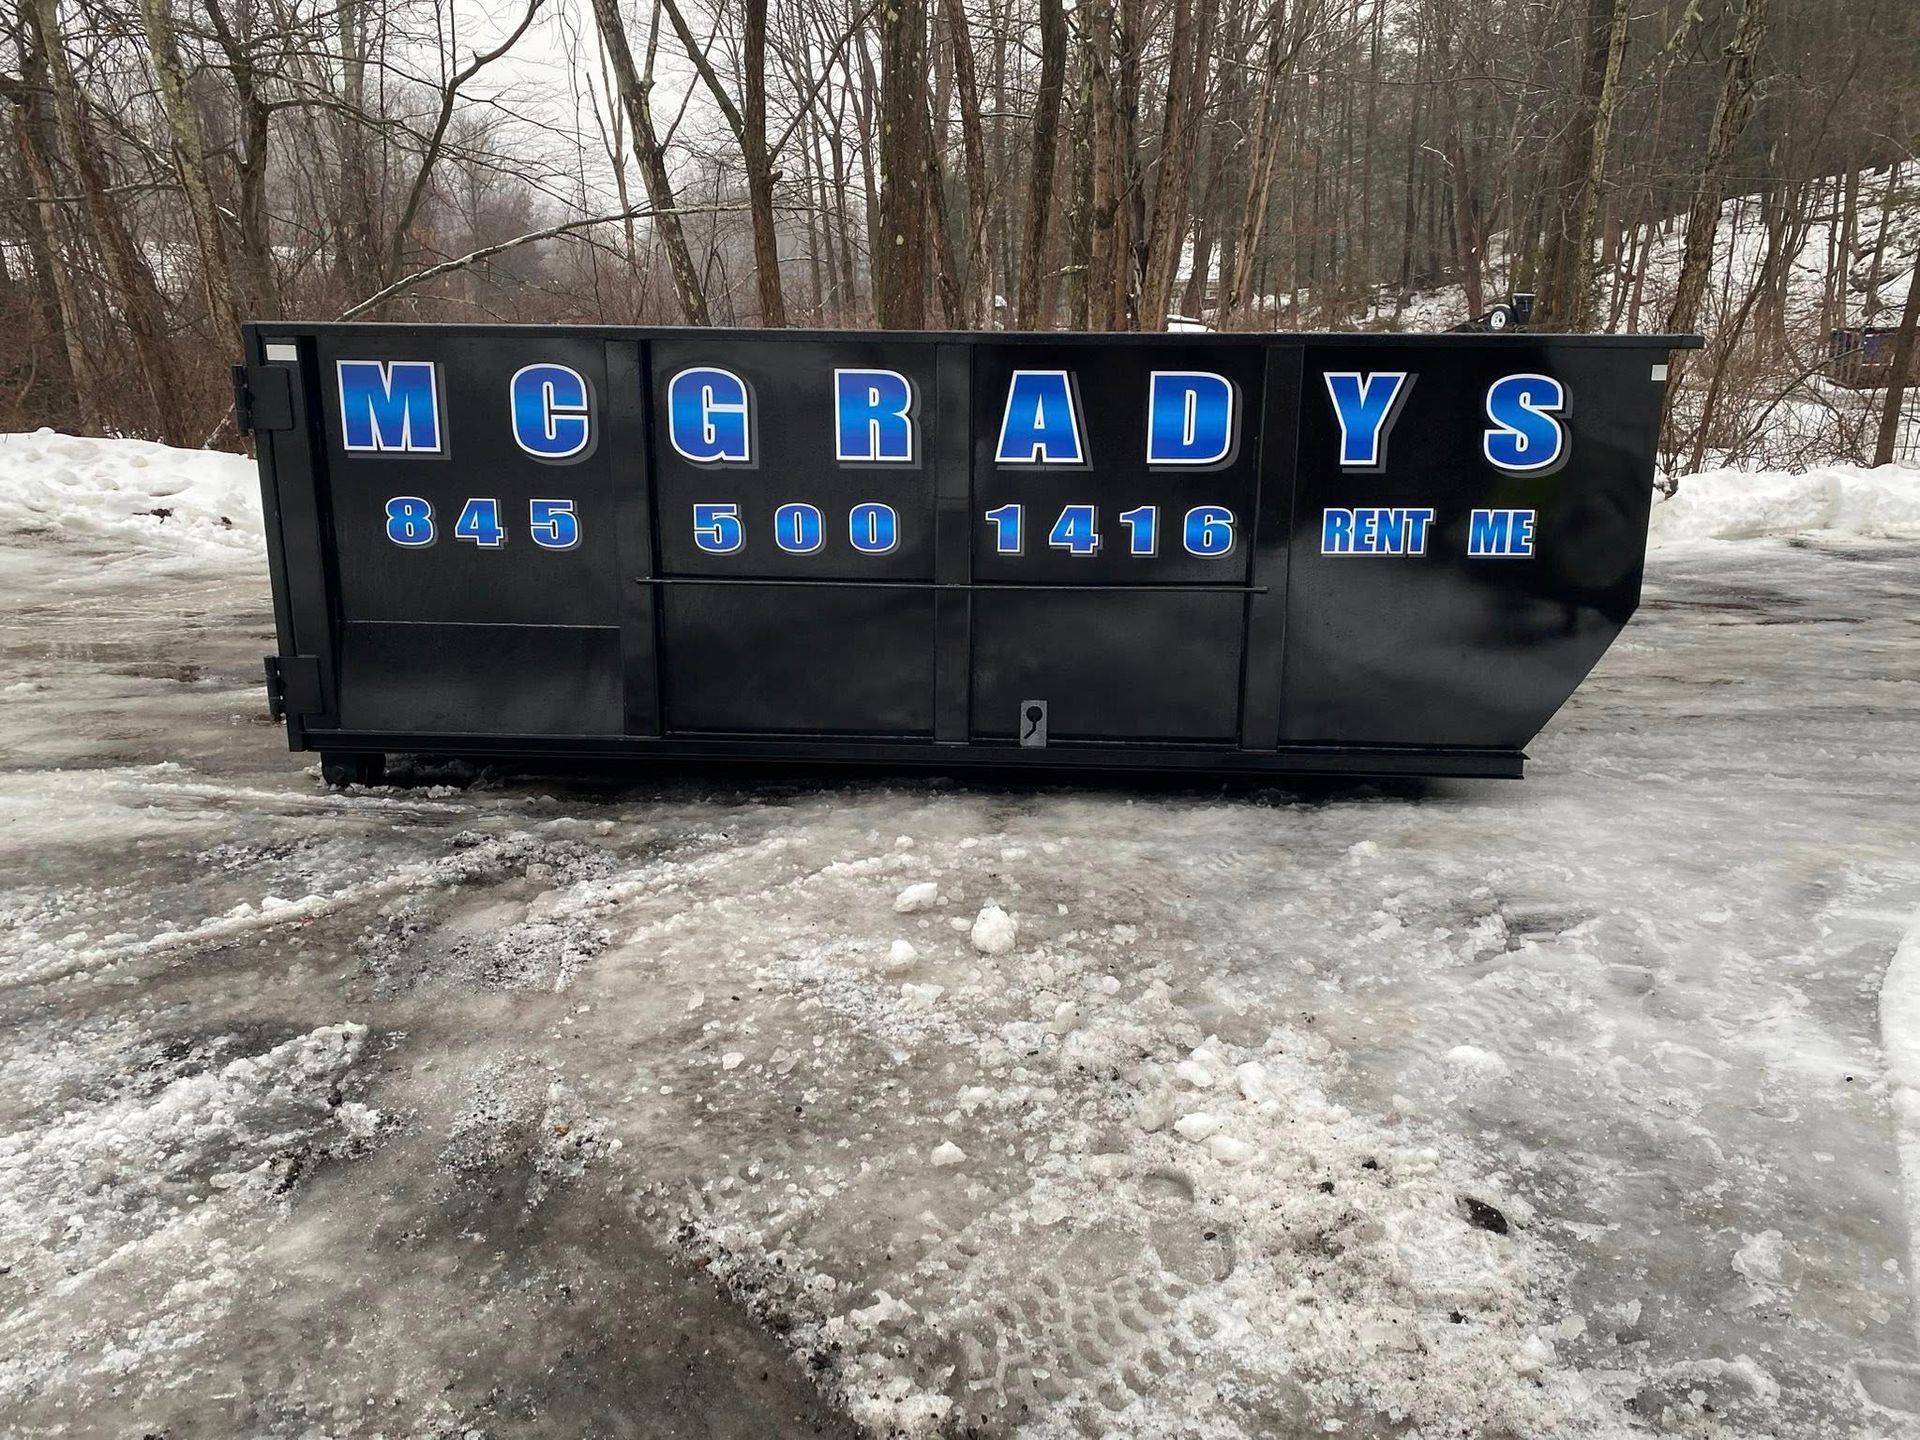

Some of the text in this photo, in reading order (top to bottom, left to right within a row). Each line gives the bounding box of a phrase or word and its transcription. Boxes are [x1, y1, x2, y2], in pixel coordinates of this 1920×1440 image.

[385, 496, 1235, 556] 845 500 1416
[1320, 507, 1536, 559] RENT ME
